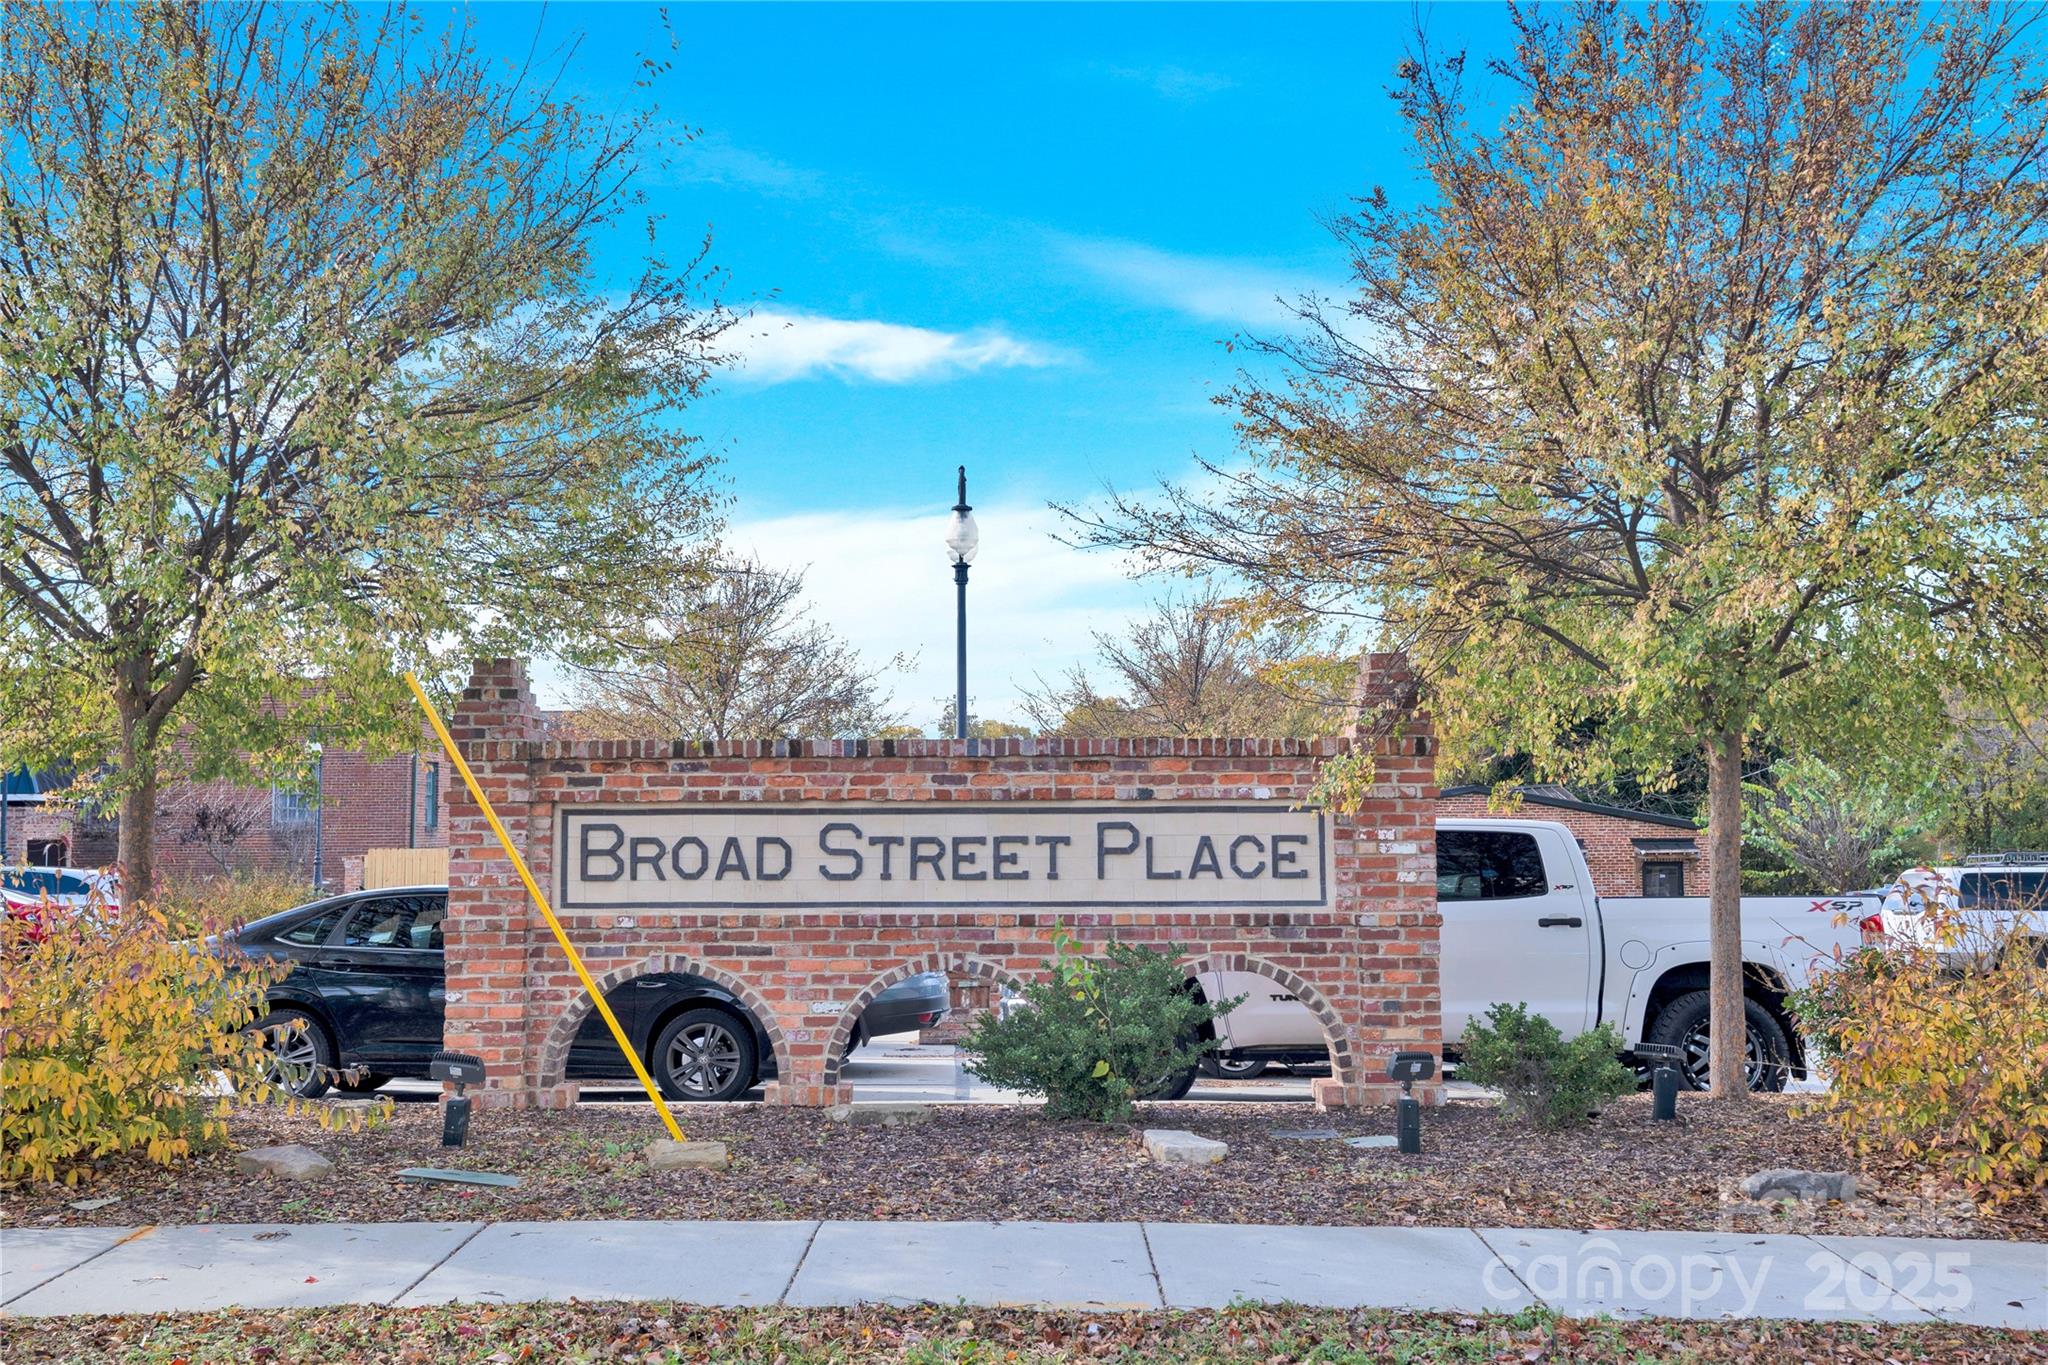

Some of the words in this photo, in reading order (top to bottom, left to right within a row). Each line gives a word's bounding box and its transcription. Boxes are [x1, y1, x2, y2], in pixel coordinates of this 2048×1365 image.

[581, 824, 793, 882] BROAD
[820, 823, 1072, 882] STREET
[1098, 822, 1309, 881] PLACE
